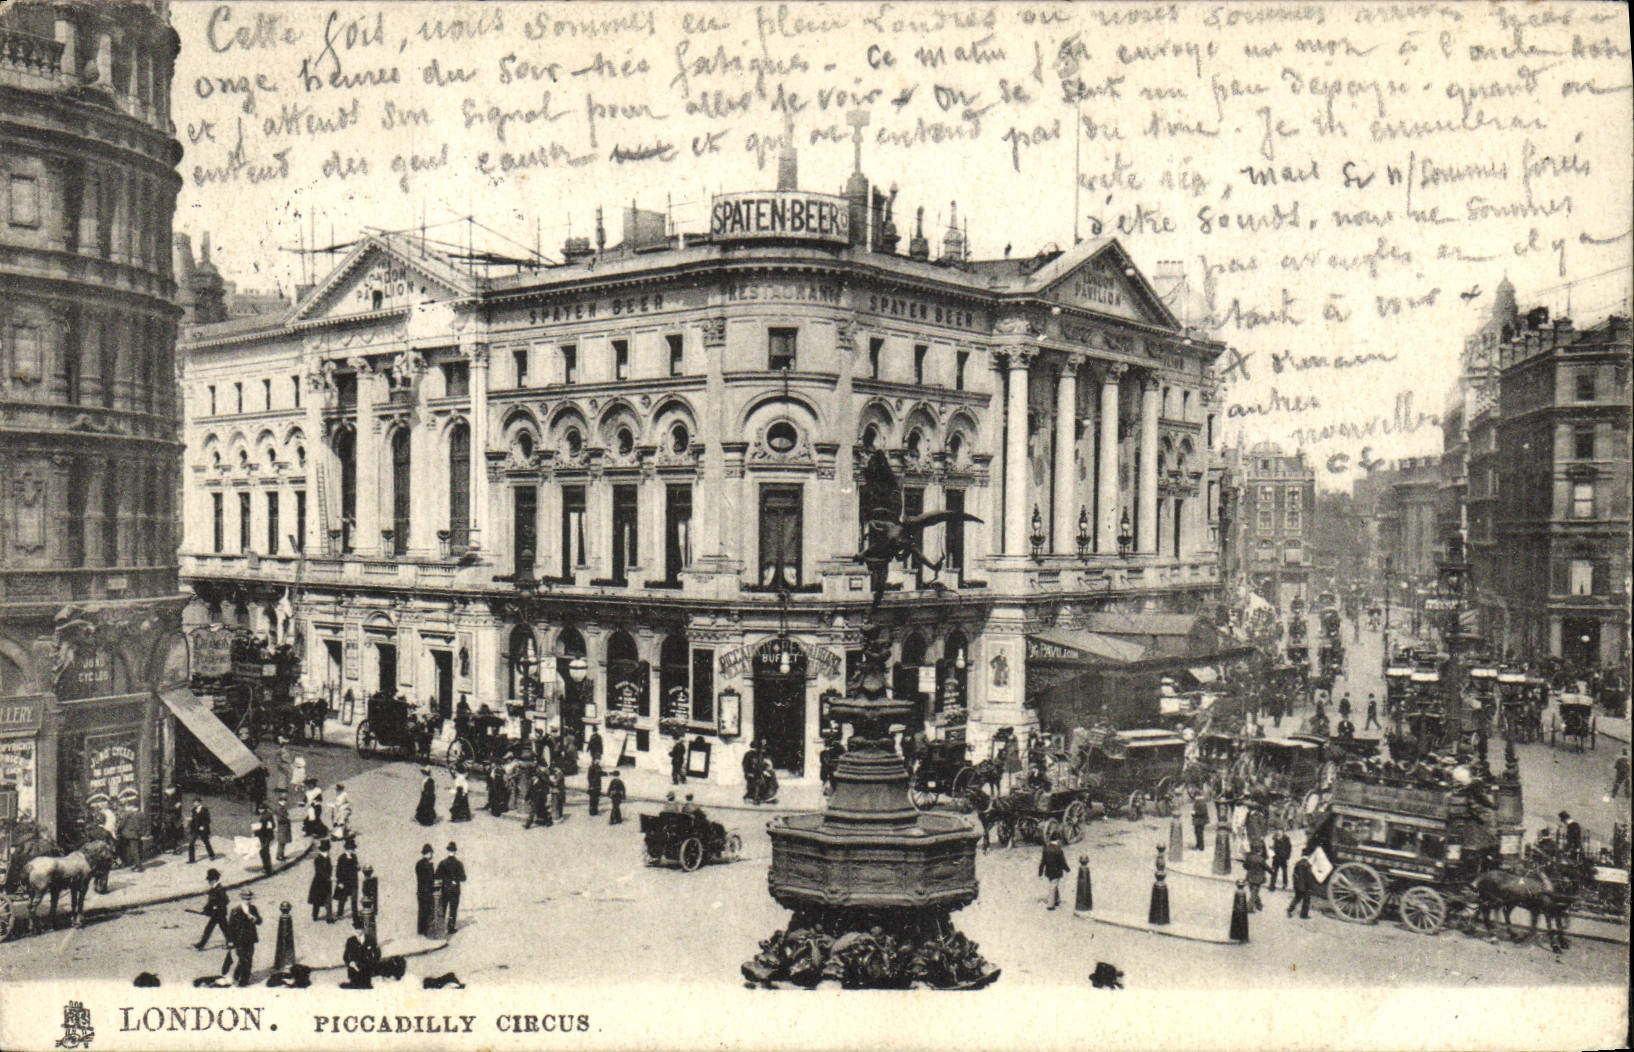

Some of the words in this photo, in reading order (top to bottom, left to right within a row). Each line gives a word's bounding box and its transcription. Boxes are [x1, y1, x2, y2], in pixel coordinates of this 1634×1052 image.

[206, 5, 302, 52] Cette
[416, 8, 503, 41] nous
[422, 58, 476, 86] du
[868, 44, 896, 69] Ce
[187, 120, 215, 144] et
[365, 267, 407, 285] ONDON
[356, 280, 414, 303] PALION
[529, 302, 597, 325] SPATEN
[612, 294, 663, 315] BEER
[870, 295, 927, 319] SPATEN
[936, 307, 972, 328] BEER
[762, 653, 799, 664] BUFT
